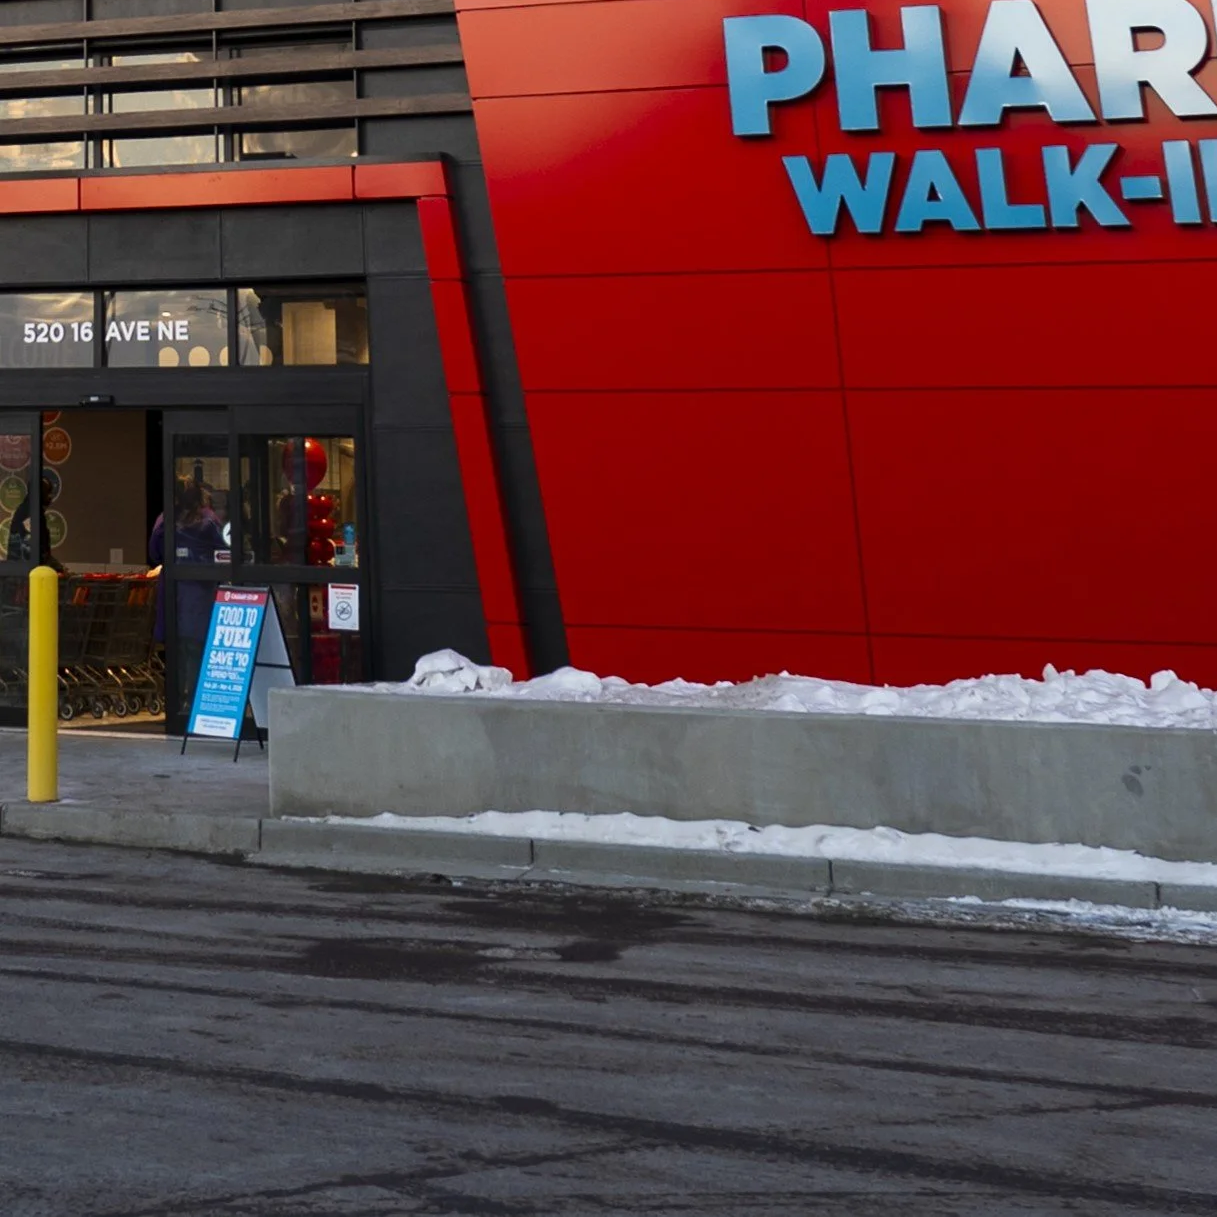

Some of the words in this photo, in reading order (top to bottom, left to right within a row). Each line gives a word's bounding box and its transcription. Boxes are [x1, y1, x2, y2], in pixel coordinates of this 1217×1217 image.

[24, 322, 64, 343] 520
[71, 321, 94, 343] 16
[105, 320, 151, 342] AVE
[157, 320, 189, 341] NE
[218, 606, 244, 626] FOOD
[245, 608, 258, 628] TO
[213, 625, 252, 648] FUEL
[209, 650, 234, 665] SAVE
